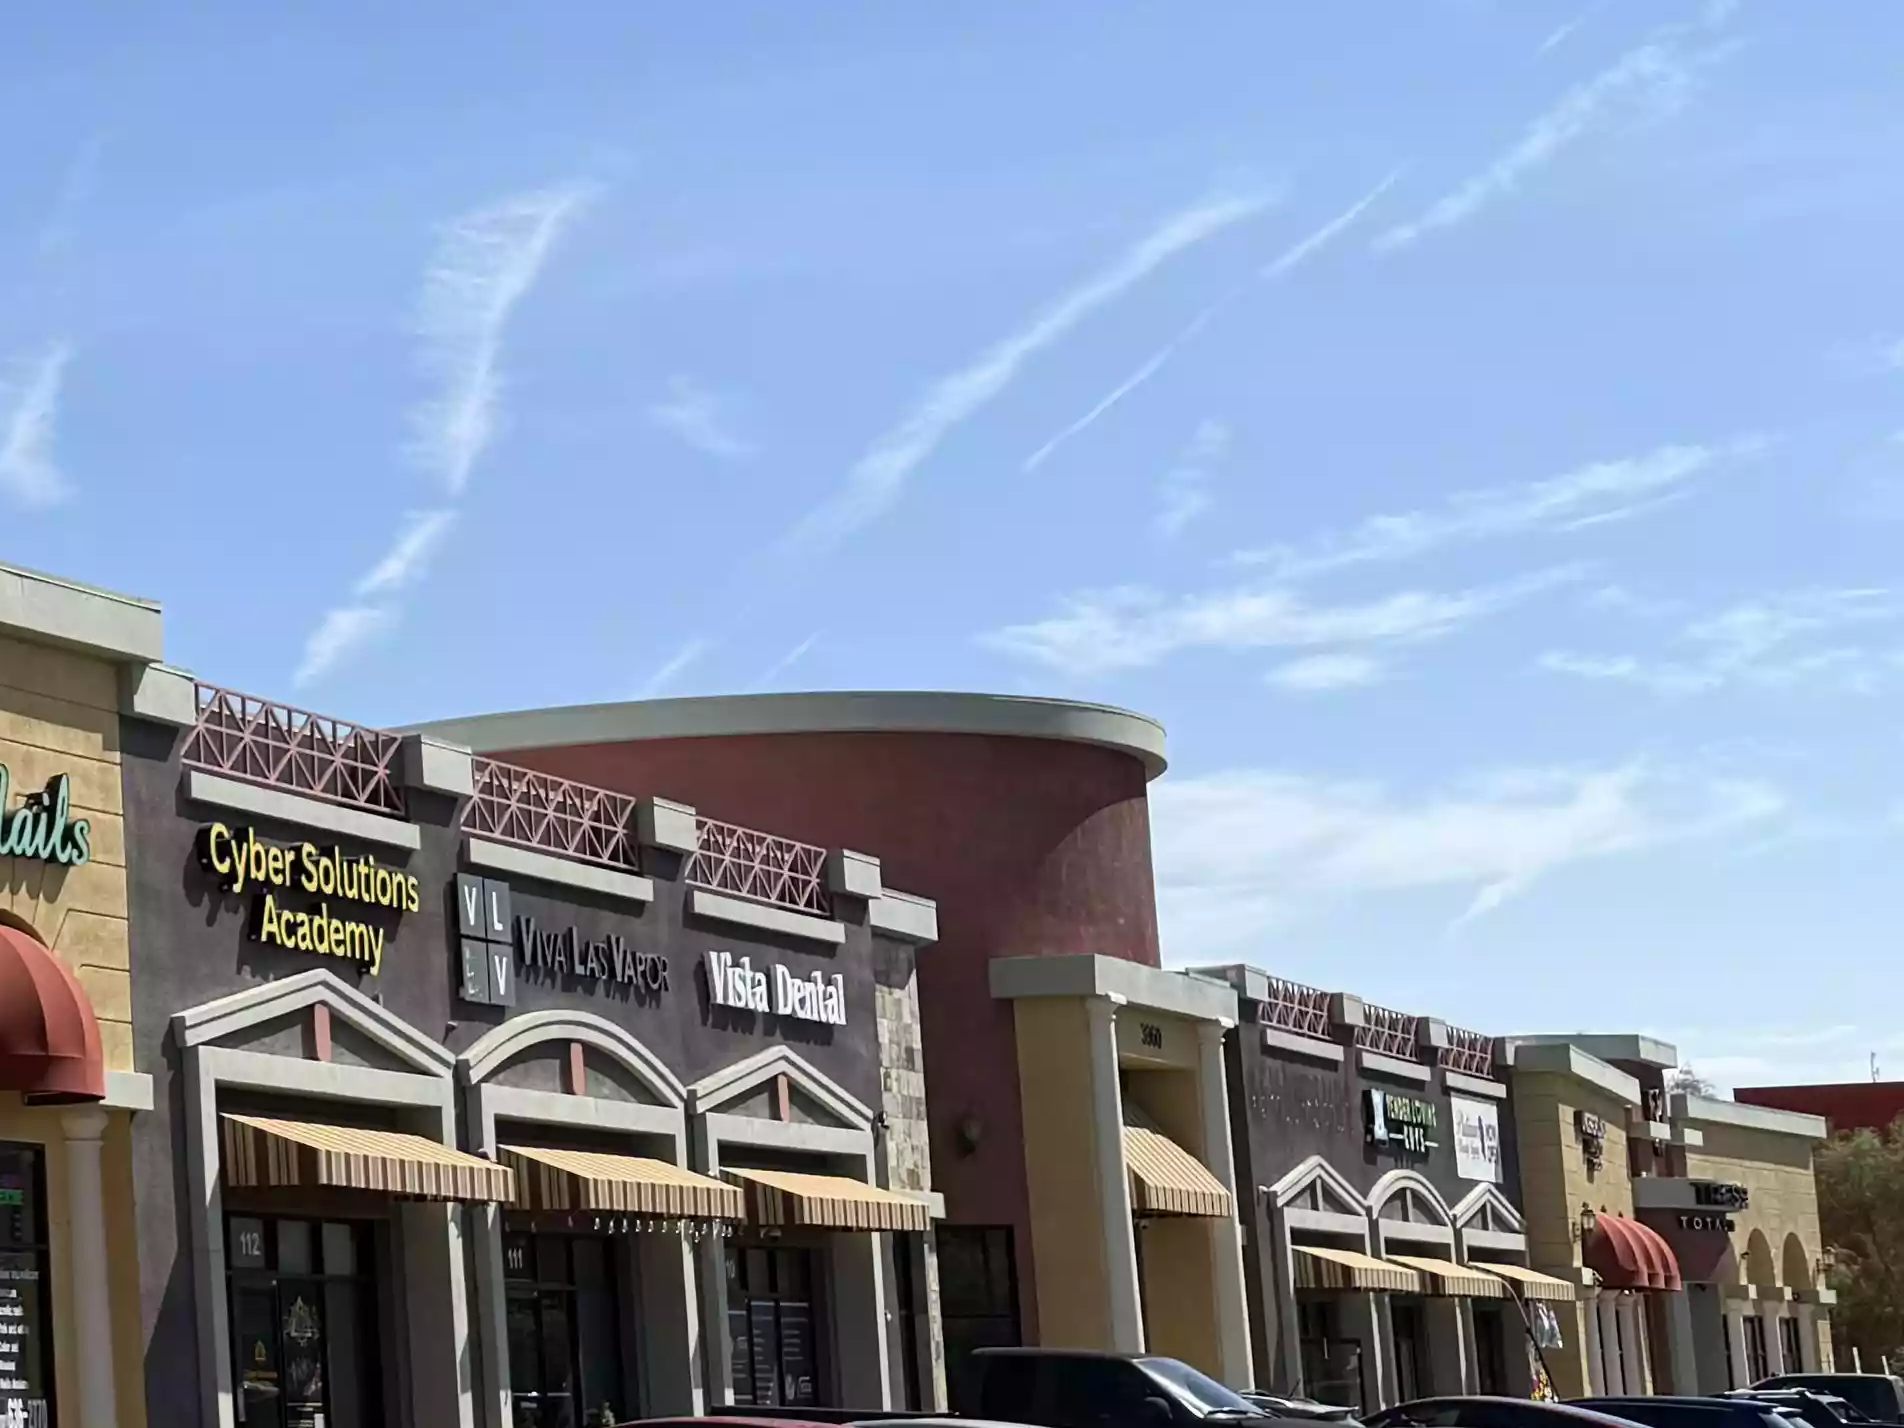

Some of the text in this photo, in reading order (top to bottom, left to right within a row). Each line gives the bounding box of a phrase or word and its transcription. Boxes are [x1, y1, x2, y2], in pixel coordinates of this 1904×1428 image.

[208, 822, 420, 913] Cyber Solutions
[260, 894, 385, 977] Academy
[707, 950, 847, 1027] Vista Dental
[240, 1231, 261, 1255] 112
